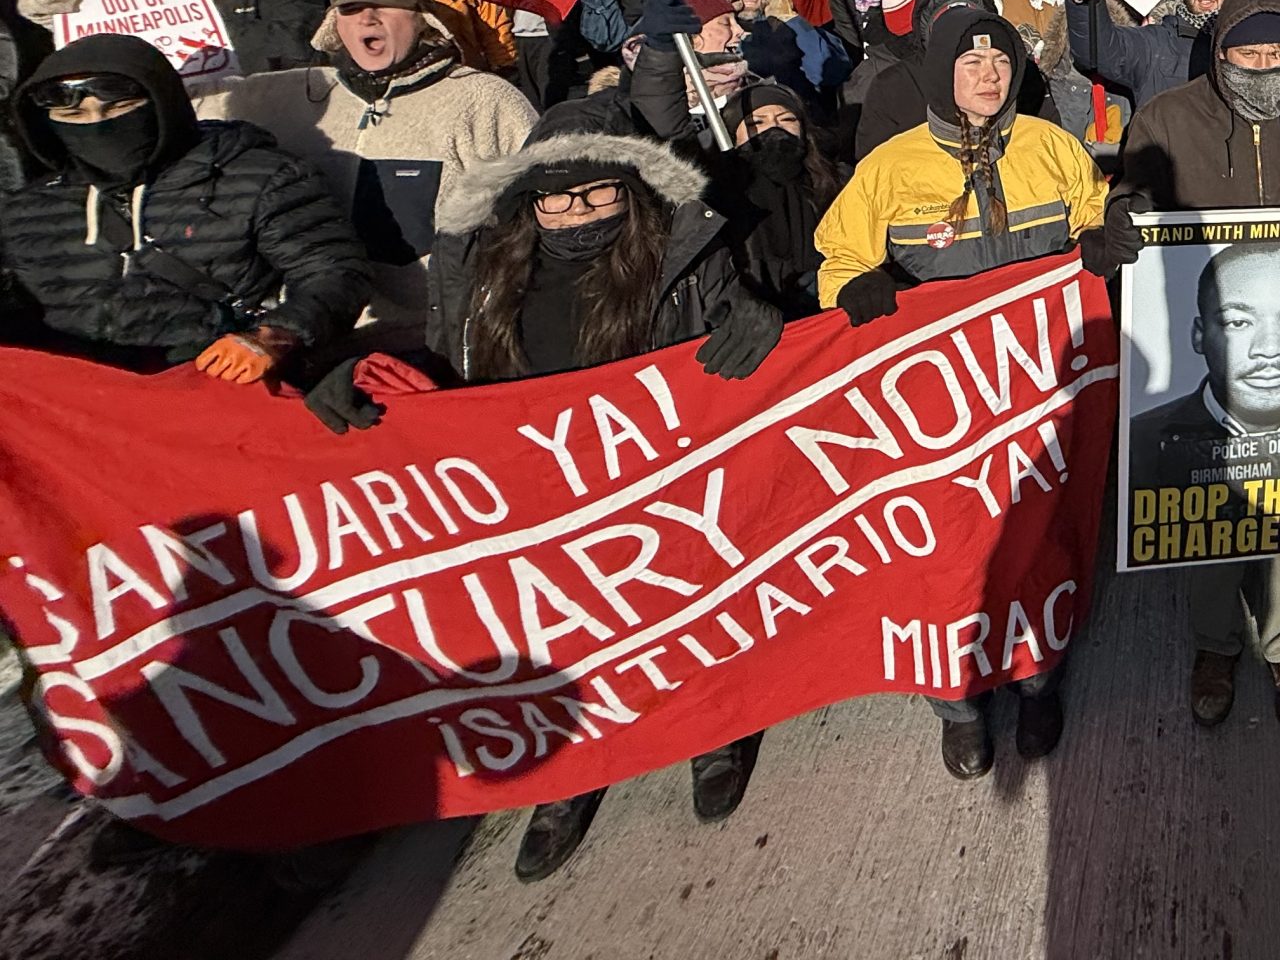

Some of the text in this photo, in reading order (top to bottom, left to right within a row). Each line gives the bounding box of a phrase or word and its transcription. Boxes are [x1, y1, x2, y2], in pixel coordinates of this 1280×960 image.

[76, 2, 204, 37] MINNEAPOLIS
[1141, 226, 1193, 243] STAND
[1202, 224, 1243, 241] WITH
[784, 279, 1088, 496] NOW!
[518, 364, 692, 498] YA!
[1212, 441, 1258, 460] POLICE
[951, 419, 1070, 518] YA!
[1191, 462, 1271, 484] BIRMINGHAM
[1134, 484, 1229, 525] DROP
[881, 580, 1077, 689] MIRAC
